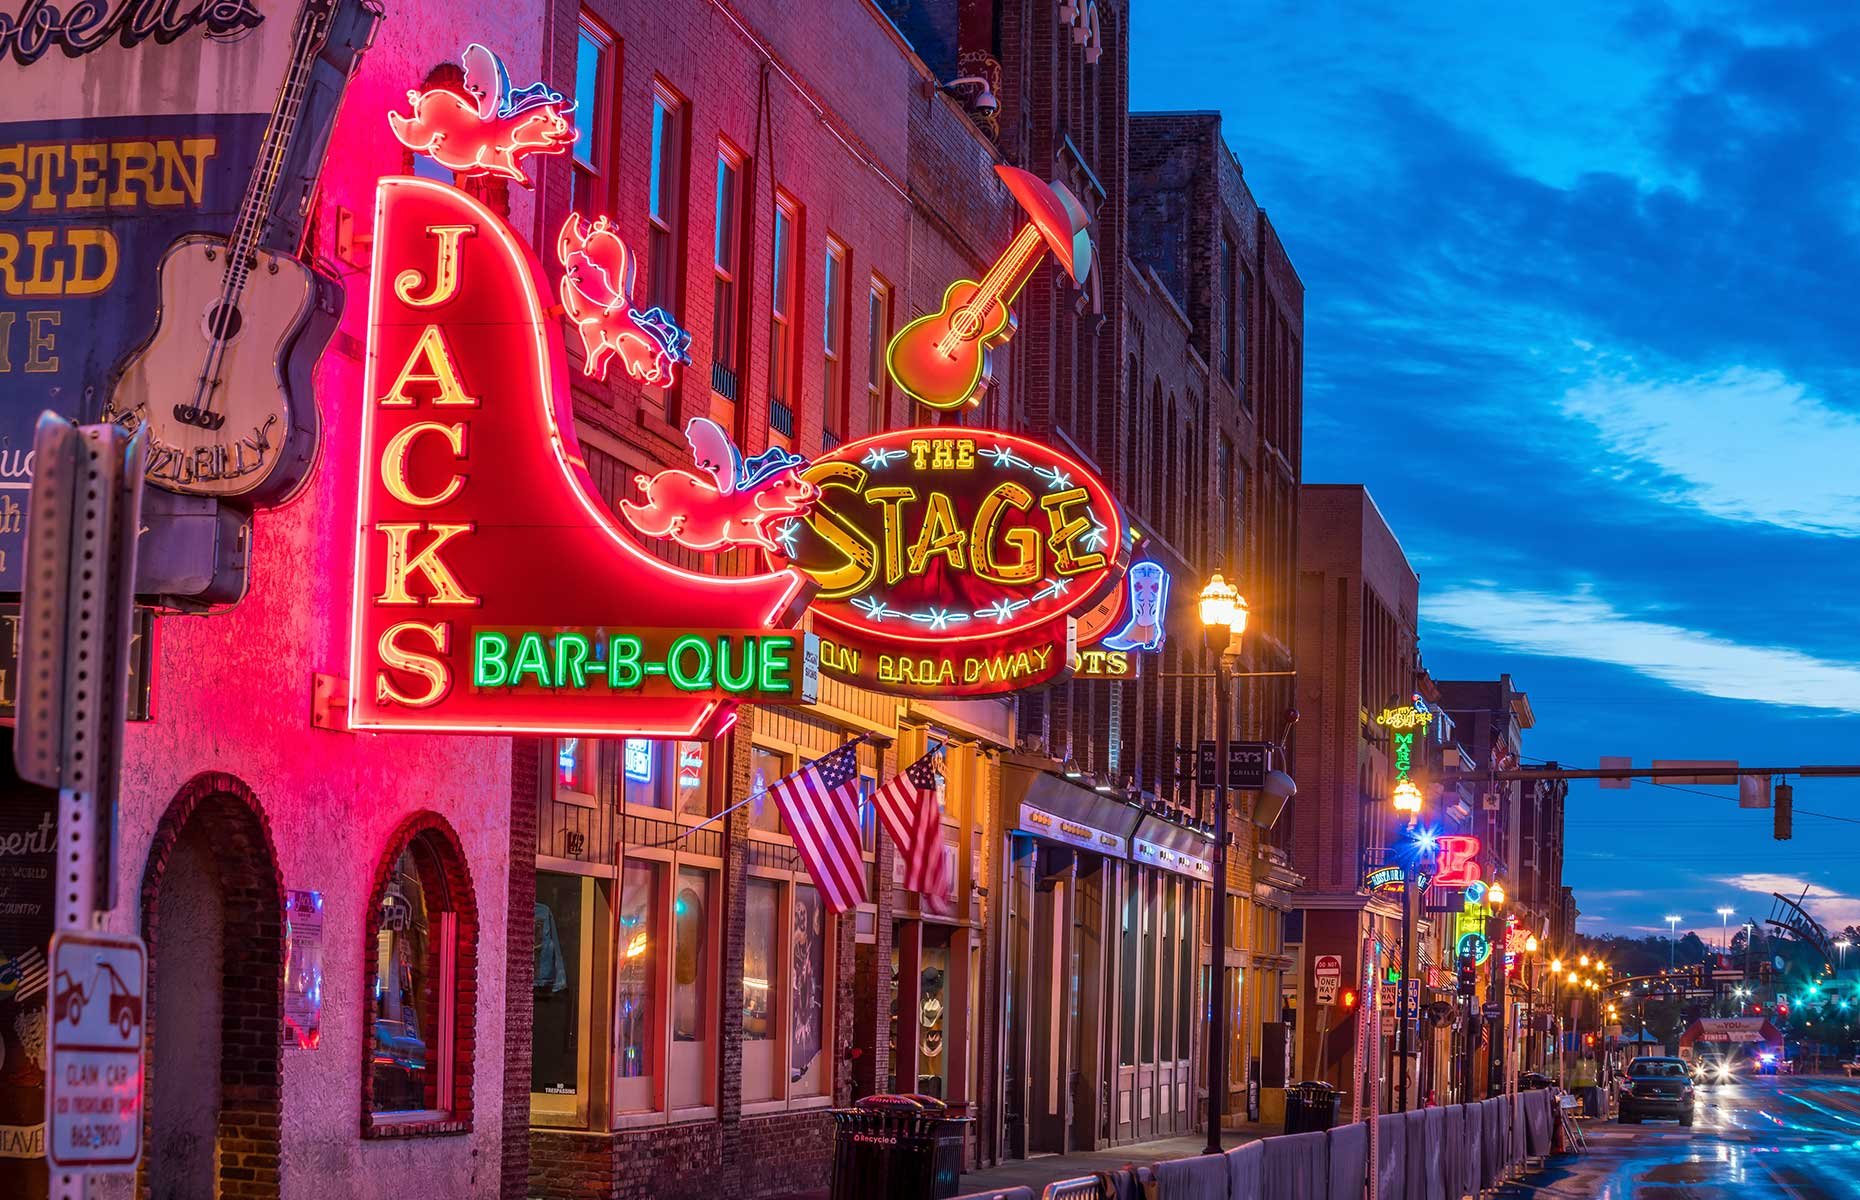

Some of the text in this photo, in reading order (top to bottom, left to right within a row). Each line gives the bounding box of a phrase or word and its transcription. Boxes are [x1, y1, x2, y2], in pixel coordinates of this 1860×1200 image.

[374, 224, 482, 706] JACKS
[911, 439, 976, 470] THE
[797, 460, 1108, 599] STAGE
[472, 631, 794, 691] BAR-B-QUE
[820, 641, 860, 674] ON
[878, 644, 1053, 685] BROADWAY
[861, 1134, 890, 1145] Recycle
